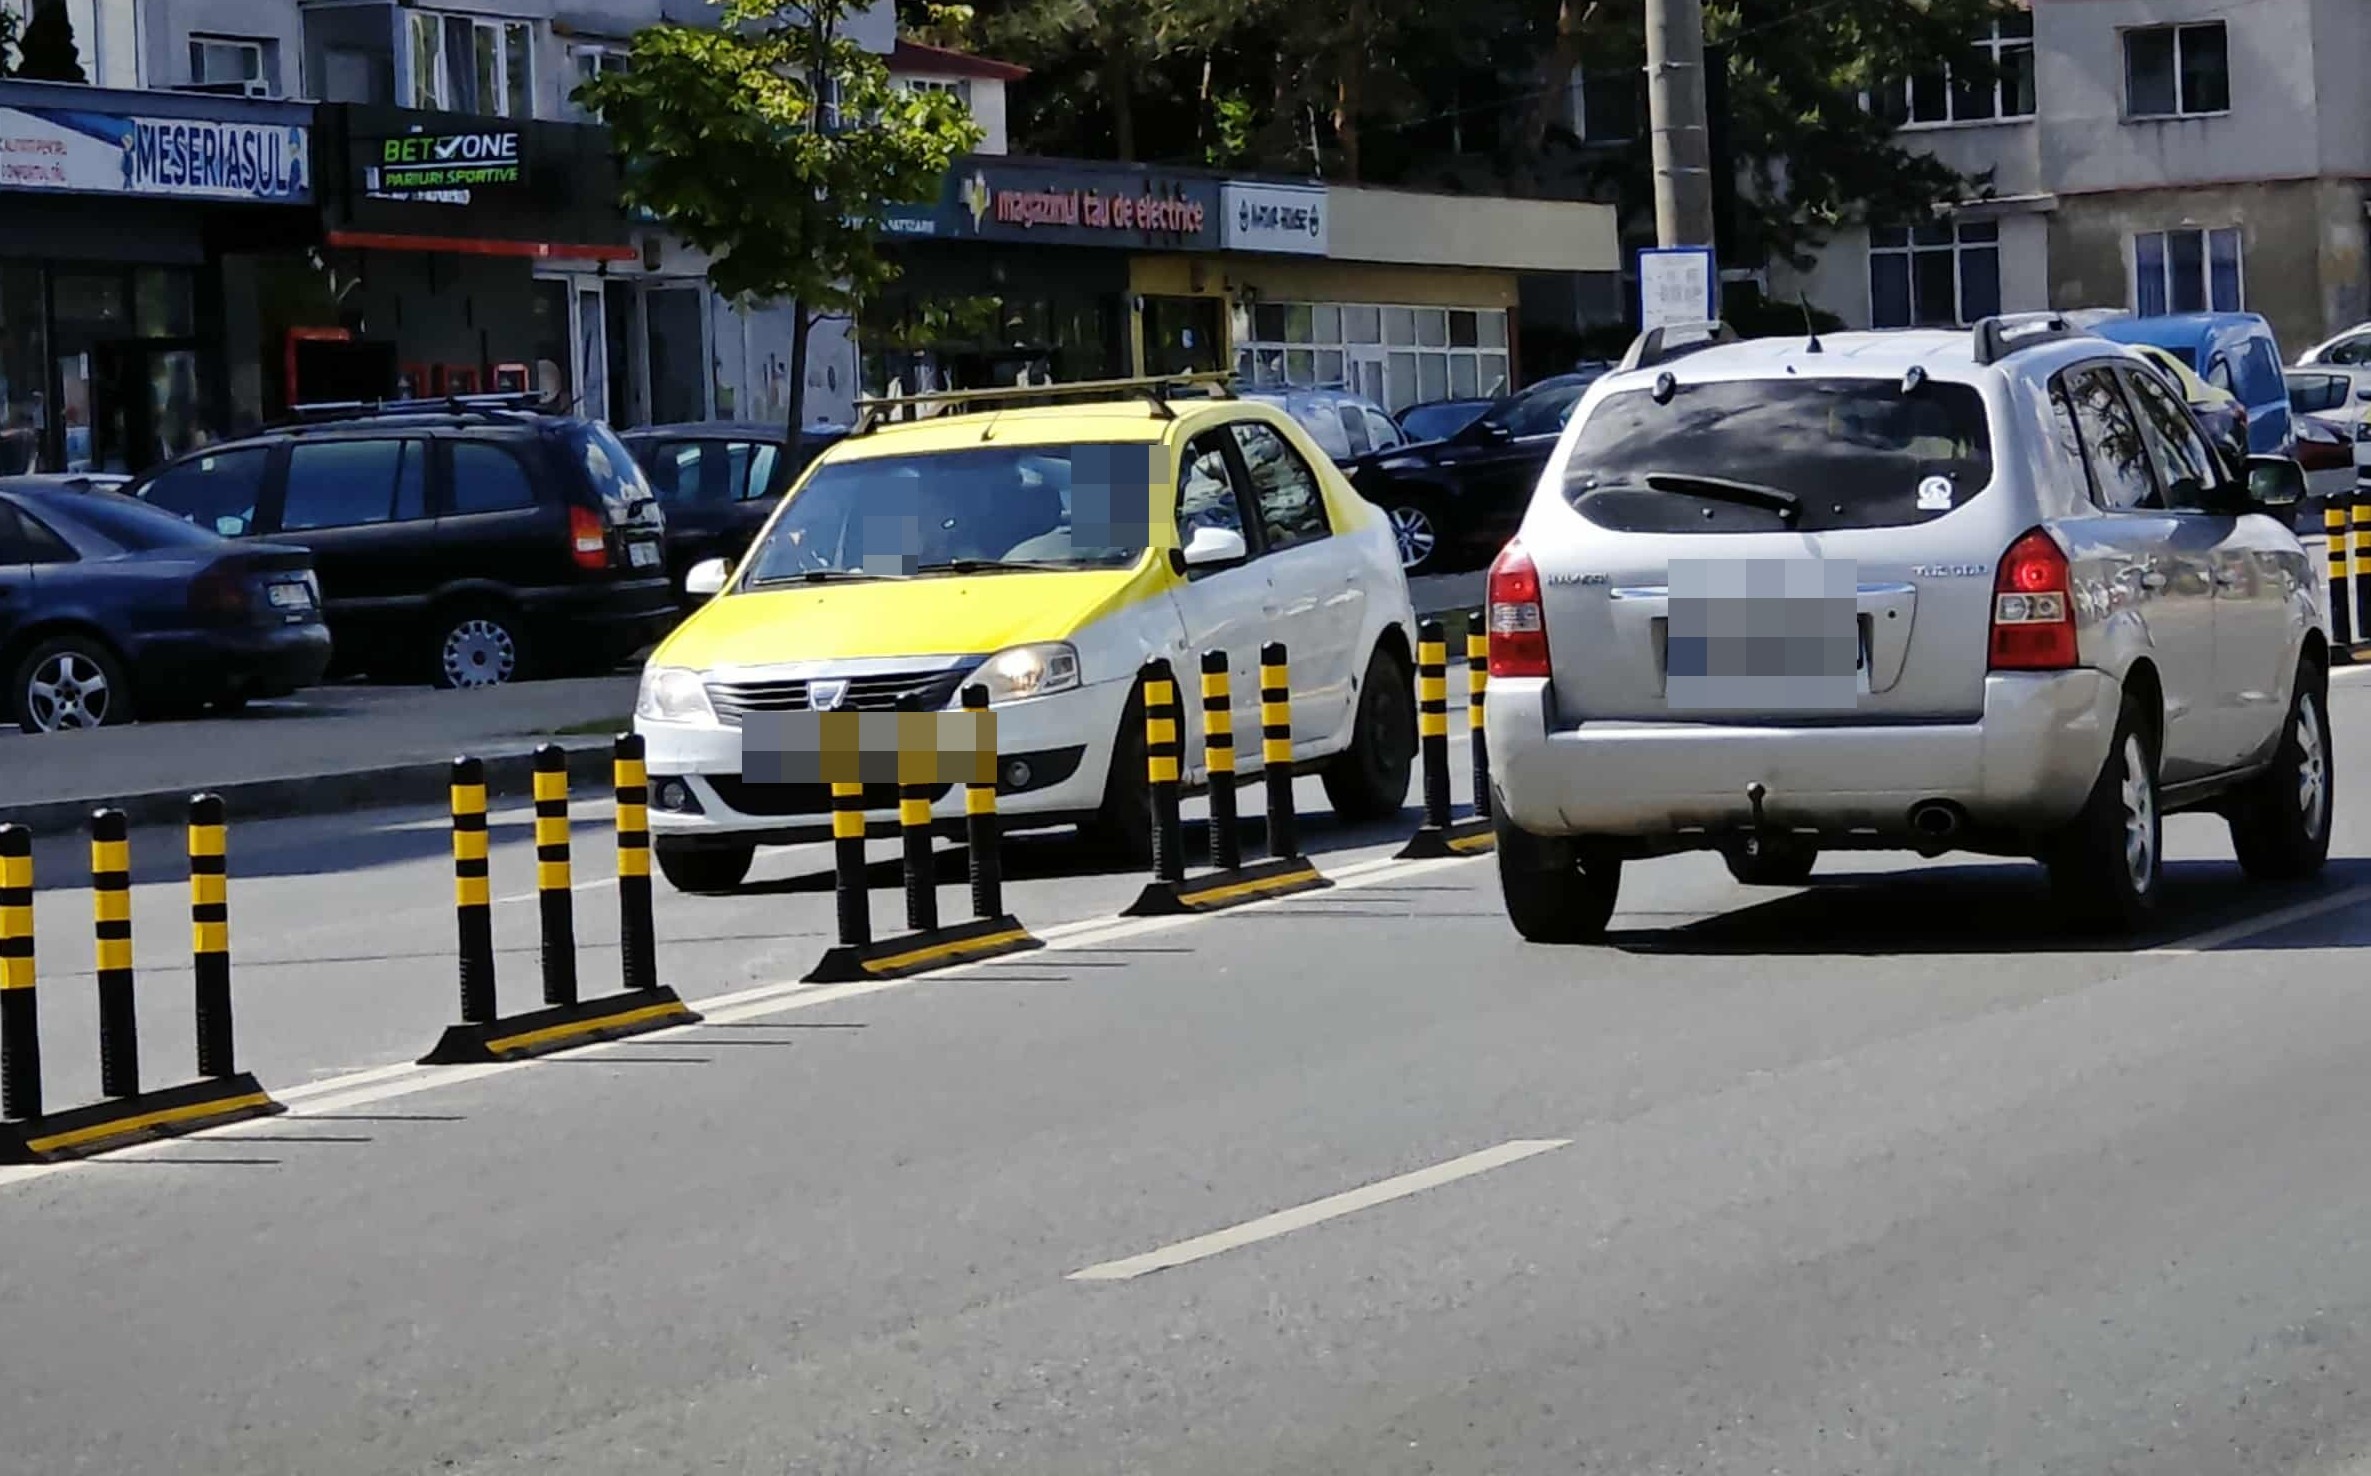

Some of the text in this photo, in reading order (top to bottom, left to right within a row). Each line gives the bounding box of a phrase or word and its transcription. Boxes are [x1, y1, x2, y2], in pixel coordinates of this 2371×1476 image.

[385, 168, 519, 187] PARIURI SPORTIVE
[996, 187, 1079, 228] magazinul
[1112, 192, 1132, 229] de
[1136, 193, 1204, 233] electrice
